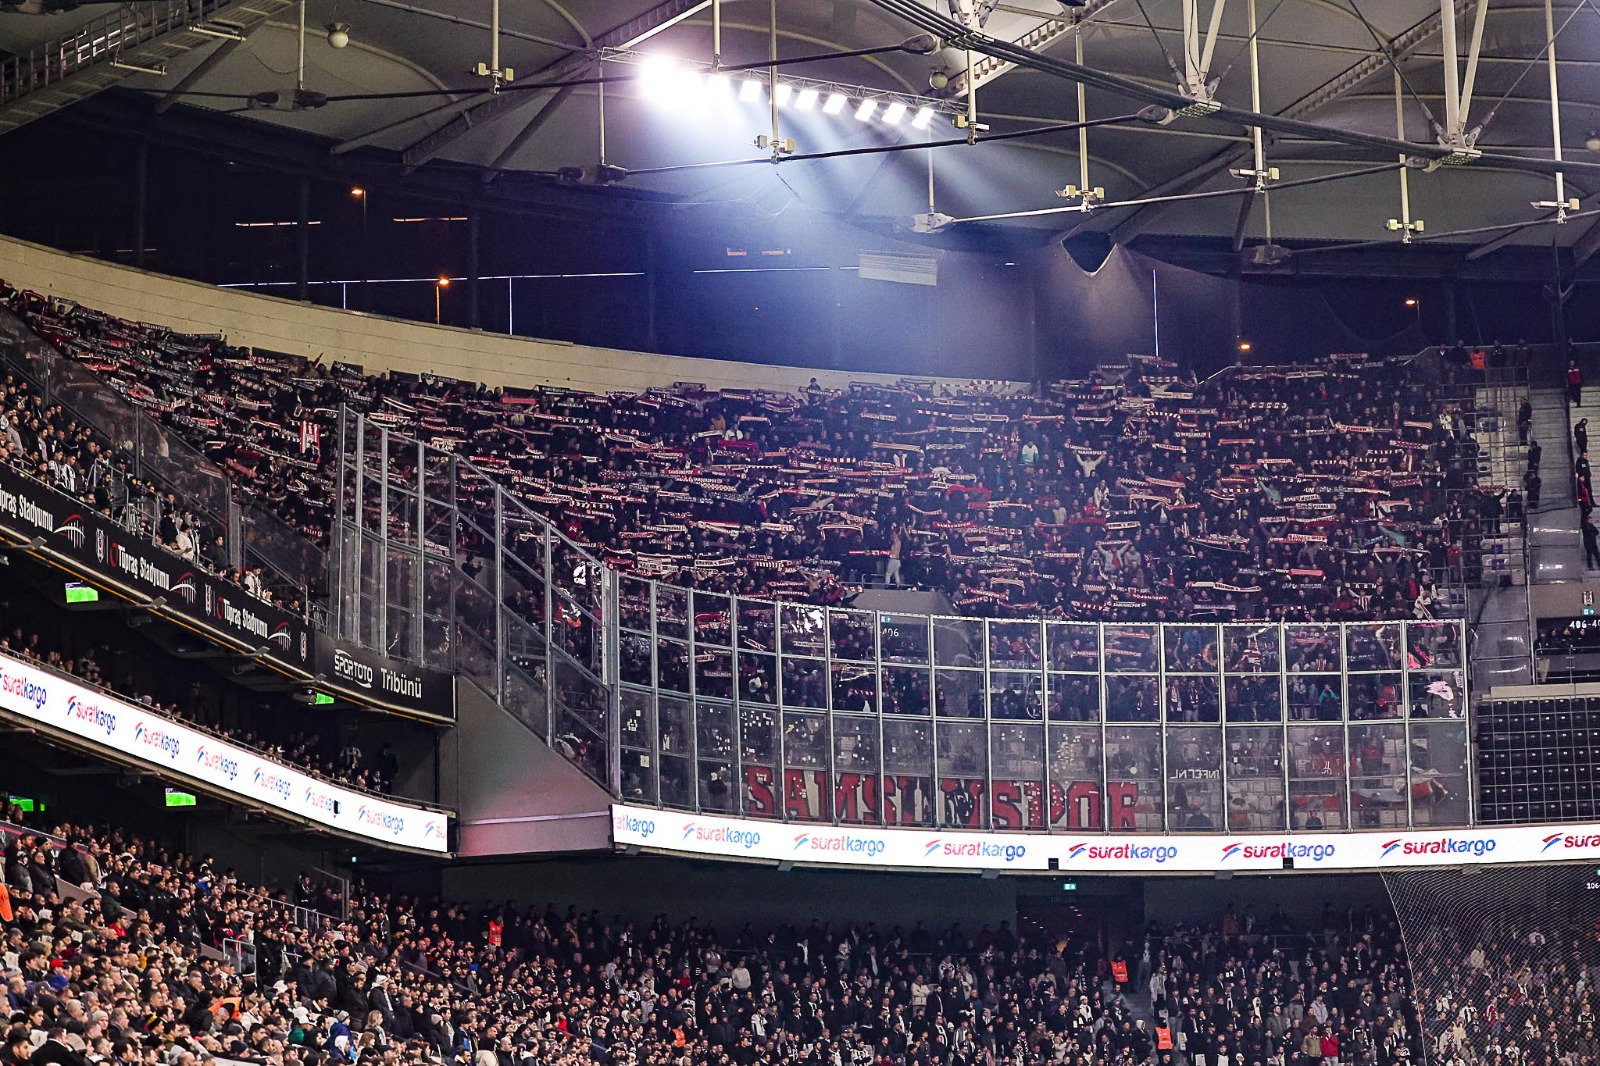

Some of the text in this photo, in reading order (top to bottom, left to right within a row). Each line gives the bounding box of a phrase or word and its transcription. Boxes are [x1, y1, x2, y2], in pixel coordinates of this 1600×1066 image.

[19, 494, 54, 532] Stadyumu
[140, 556, 170, 591] Stadyumu
[242, 608, 268, 639] Stadyumu
[380, 667, 422, 699] Tribünü
[1088, 843, 1178, 863] süratkargo
[1403, 838, 1497, 857] süratkargo
